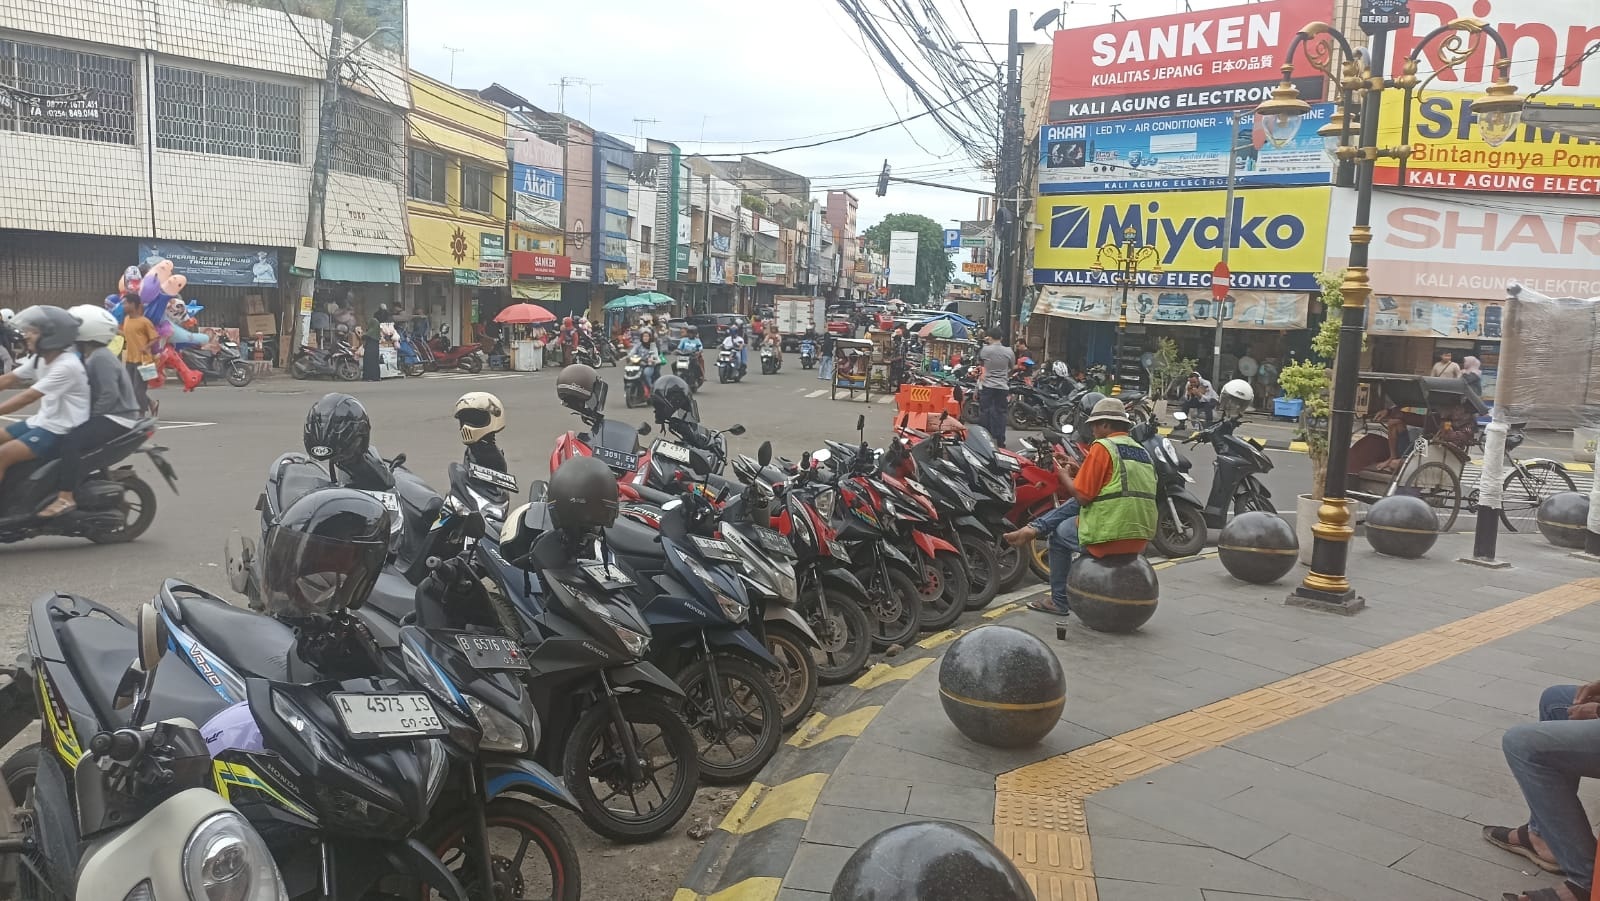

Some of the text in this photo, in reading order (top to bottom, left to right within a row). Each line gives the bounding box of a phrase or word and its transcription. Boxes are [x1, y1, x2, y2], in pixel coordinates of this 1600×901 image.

[1092, 11, 1281, 67] SANKEN
[1211, 55, 1273, 74] 日本の品質
[1091, 63, 1203, 87] KUALITAS JEPANG
[1069, 102, 1105, 117] KALI
[1111, 95, 1171, 113] AGUNG
[1047, 125, 1087, 140] AKARI
[1095, 125, 1113, 135] LED
[1115, 124, 1127, 134] TV
[1134, 122, 1150, 132] AIR
[1152, 117, 1216, 132] CONDITIONER
[1411, 142, 1543, 169] Bintangnya
[523, 168, 556, 198] Akari
[1104, 181, 1128, 189] KALI
[1133, 180, 1168, 188] AGUNG
[1409, 171, 1600, 192] KALI AGUNG ELECT
[946, 230, 959, 246] P
[1096, 197, 1304, 264] Miyako
[534, 256, 556, 268] SANKEN
[1054, 270, 1092, 283] KALI
[1167, 272, 1292, 288] ELECRONIC
[1415, 272, 1453, 288] KALI
[604, 450, 621, 460] 3091
[684, 601, 707, 618] HONDA
[459, 637, 471, 650] B
[473, 638, 501, 651] 6576
[582, 641, 609, 659] HONDA
[190, 642, 222, 687] VARIO
[340, 697, 430, 714] A 4573 IS
[267, 763, 301, 794] HONDA
